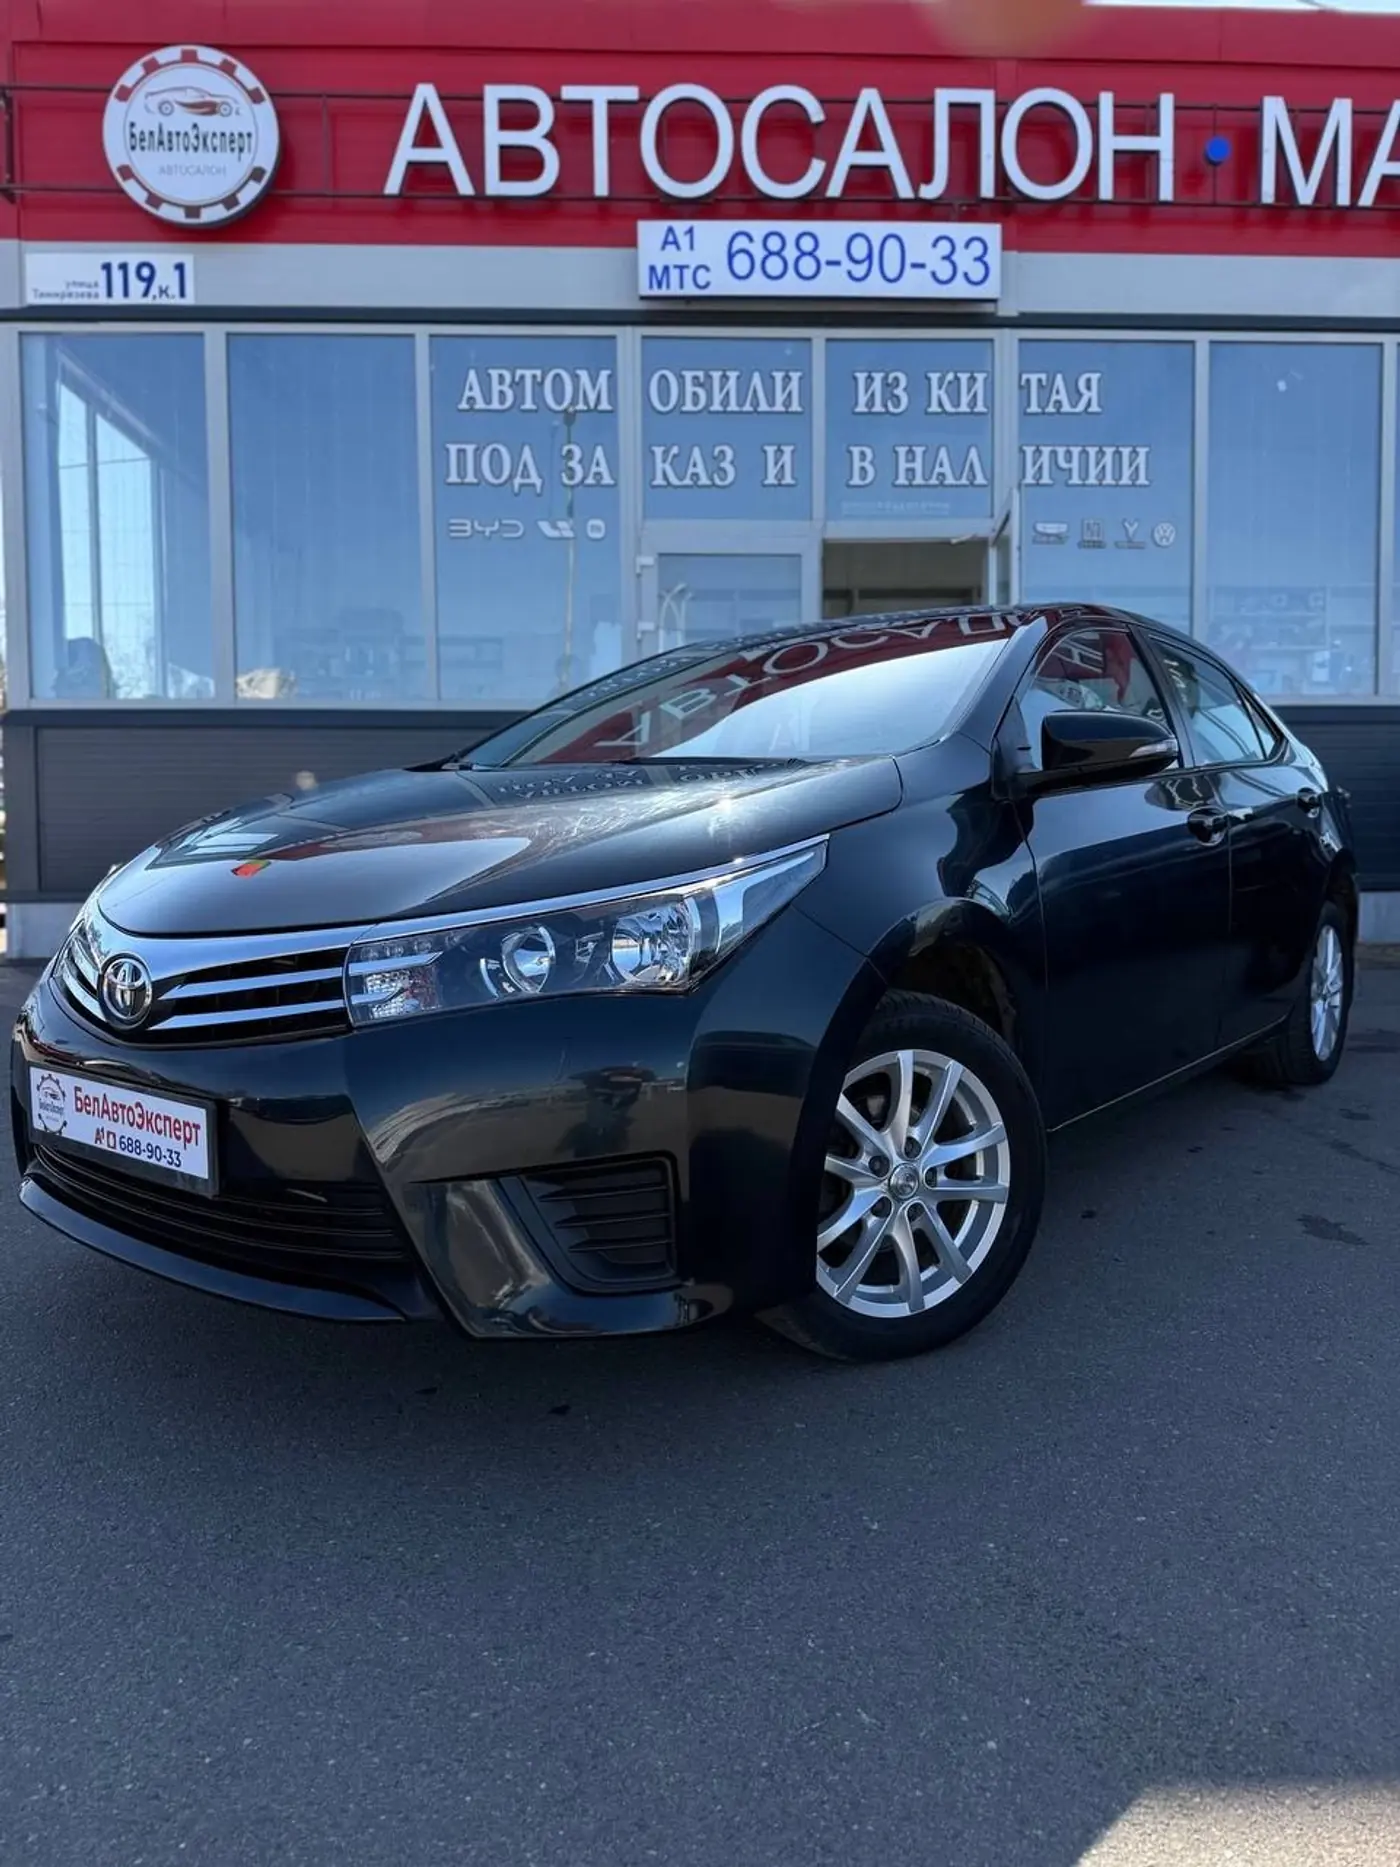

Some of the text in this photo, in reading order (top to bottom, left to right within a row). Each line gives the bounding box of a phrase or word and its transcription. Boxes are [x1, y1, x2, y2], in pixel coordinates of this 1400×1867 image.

[128, 121, 254, 162] БелАвтоЭксперт
[384, 83, 1174, 202] АВТОСАЛОН
[158, 164, 227, 177] АВТОСАЛОН
[727, 230, 990, 286] 688-90-33
[853, 371, 909, 413] ИЗ
[445, 443, 543, 495] ПОД
[761, 445, 797, 487] И
[848, 445, 876, 487] В
[74, 1086, 201, 1150] БелАвтоЭксперт
[119, 1135, 182, 1168] 688-90-33
